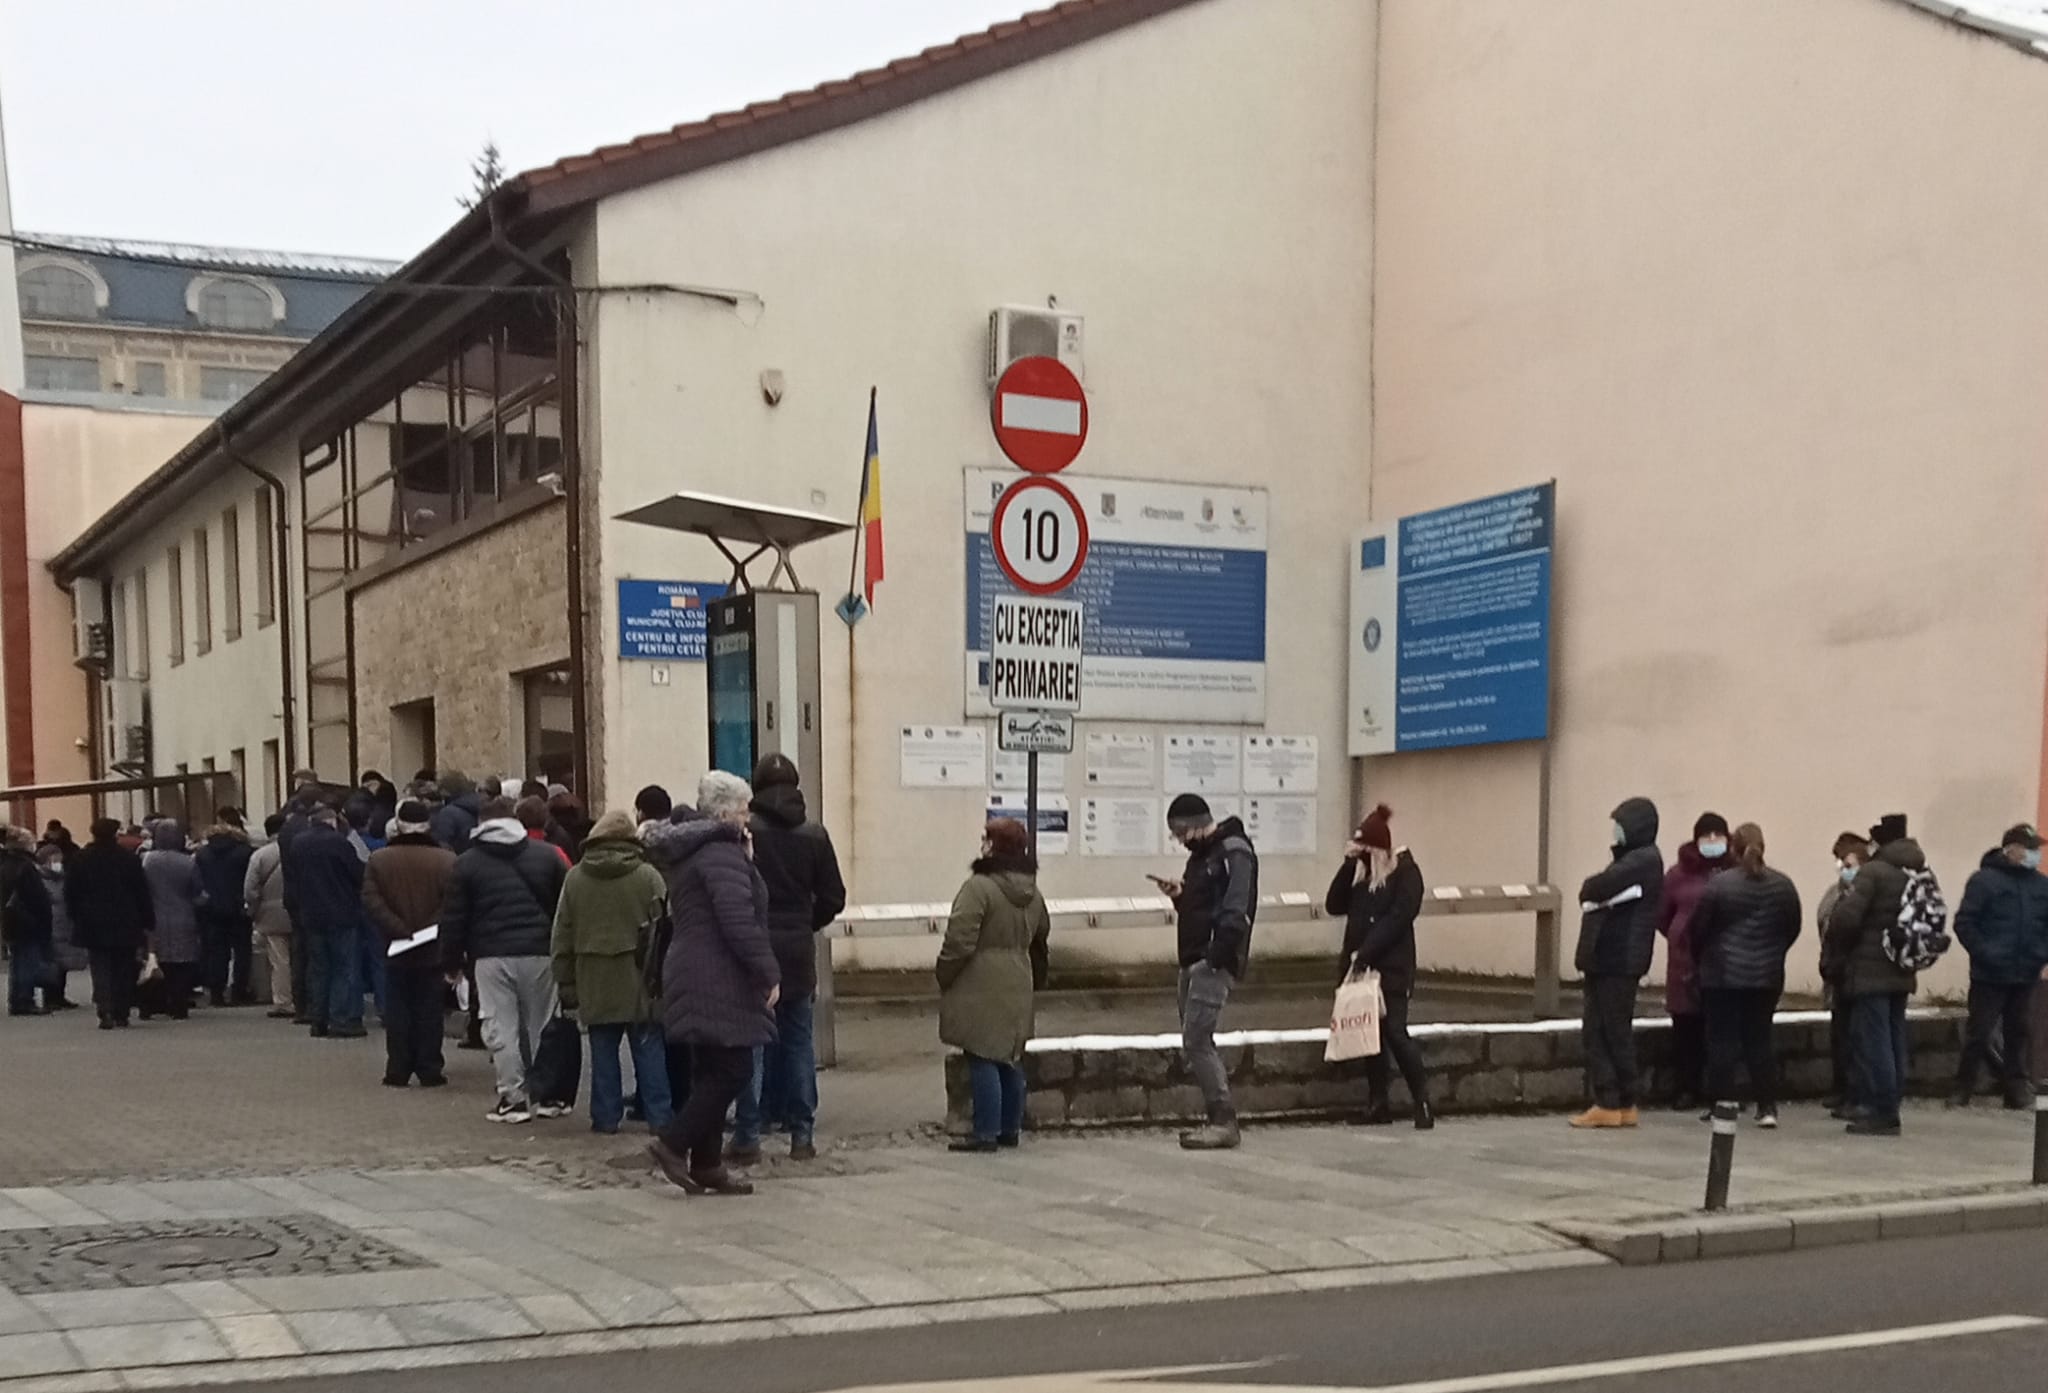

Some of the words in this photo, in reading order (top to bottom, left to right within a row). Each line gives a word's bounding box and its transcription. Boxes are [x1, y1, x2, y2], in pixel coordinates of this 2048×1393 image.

[1022, 506, 1060, 564] 10
[658, 584, 698, 596] ROMÂNIA
[996, 604, 1014, 644] CU
[1018, 605, 1080, 649] EXCEPTIA
[625, 631, 662, 643] CENTRU
[664, 632, 678, 644] DE
[638, 643, 675, 654] PENTRU
[994, 658, 1079, 702] PRIMARIEI
[1340, 1012, 1371, 1031] profi
